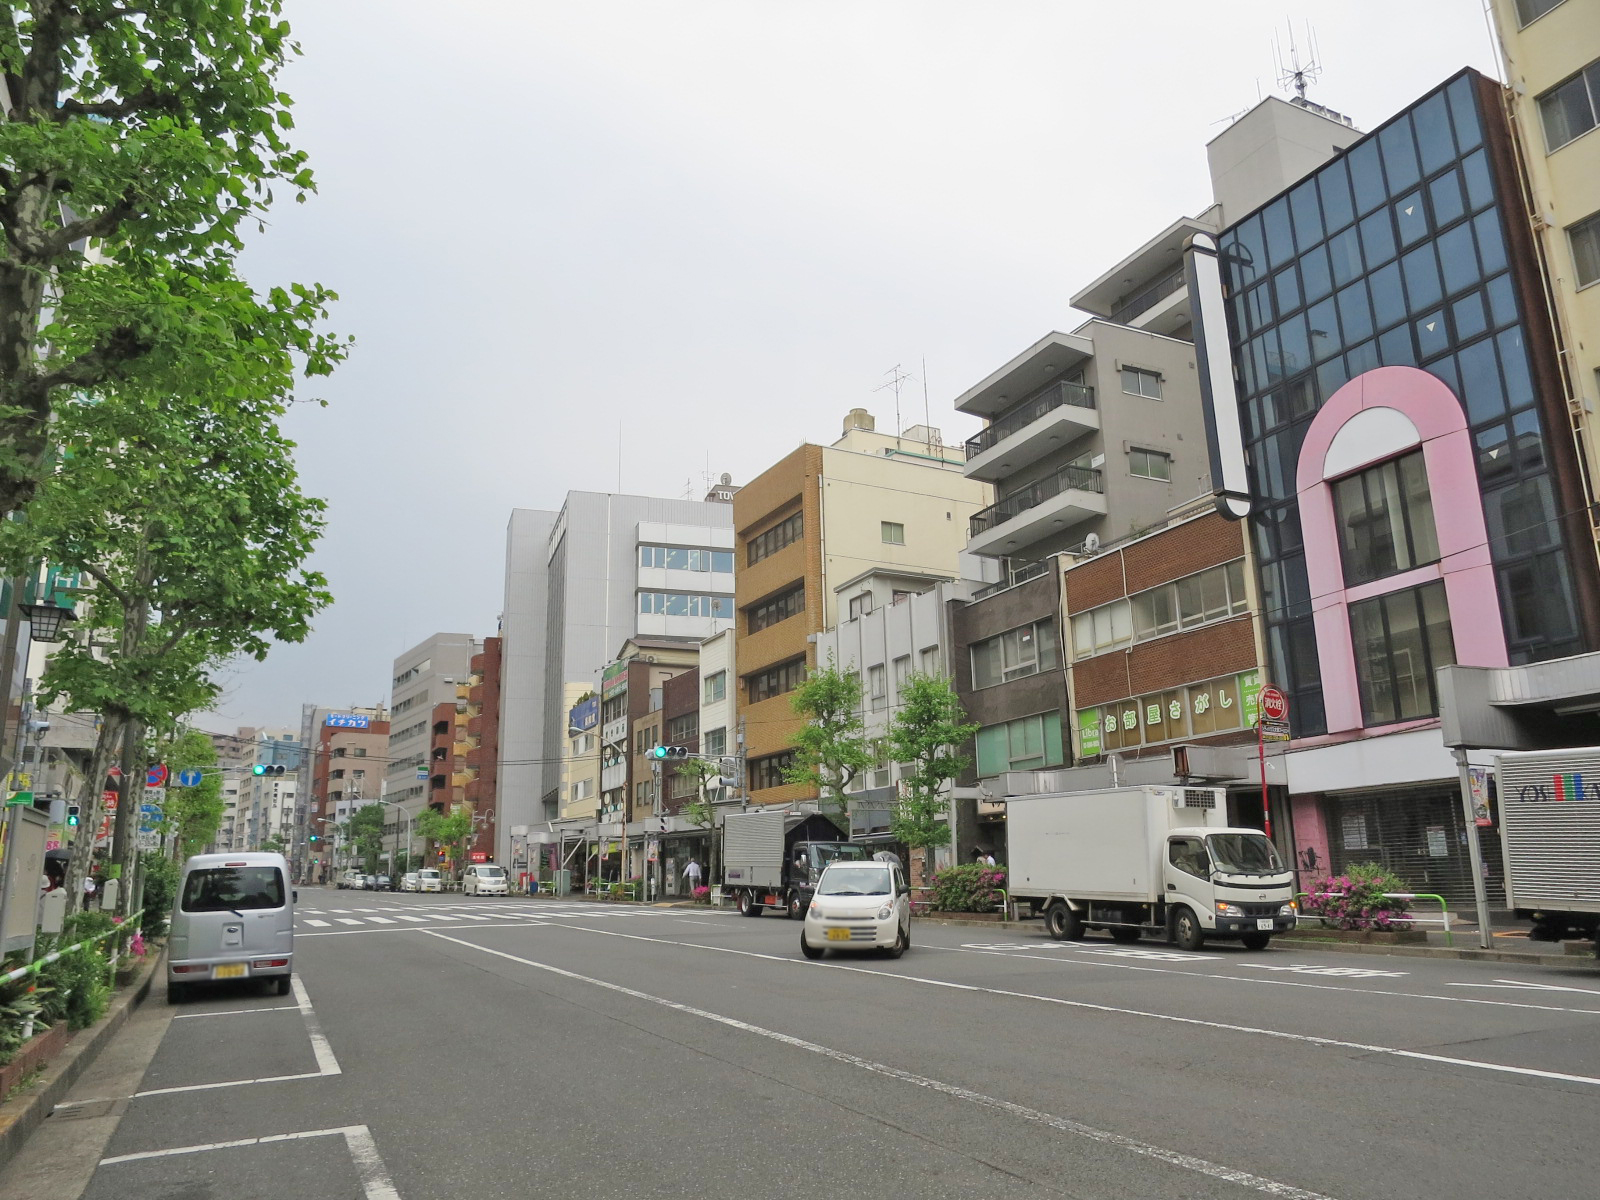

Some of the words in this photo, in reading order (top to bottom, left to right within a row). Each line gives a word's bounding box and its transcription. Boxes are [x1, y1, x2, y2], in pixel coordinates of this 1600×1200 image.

[1264, 697, 1282, 710] 消火栓
[1105, 690, 1233, 732] お部屋さがし
[329, 719, 366, 727] イチカワ
